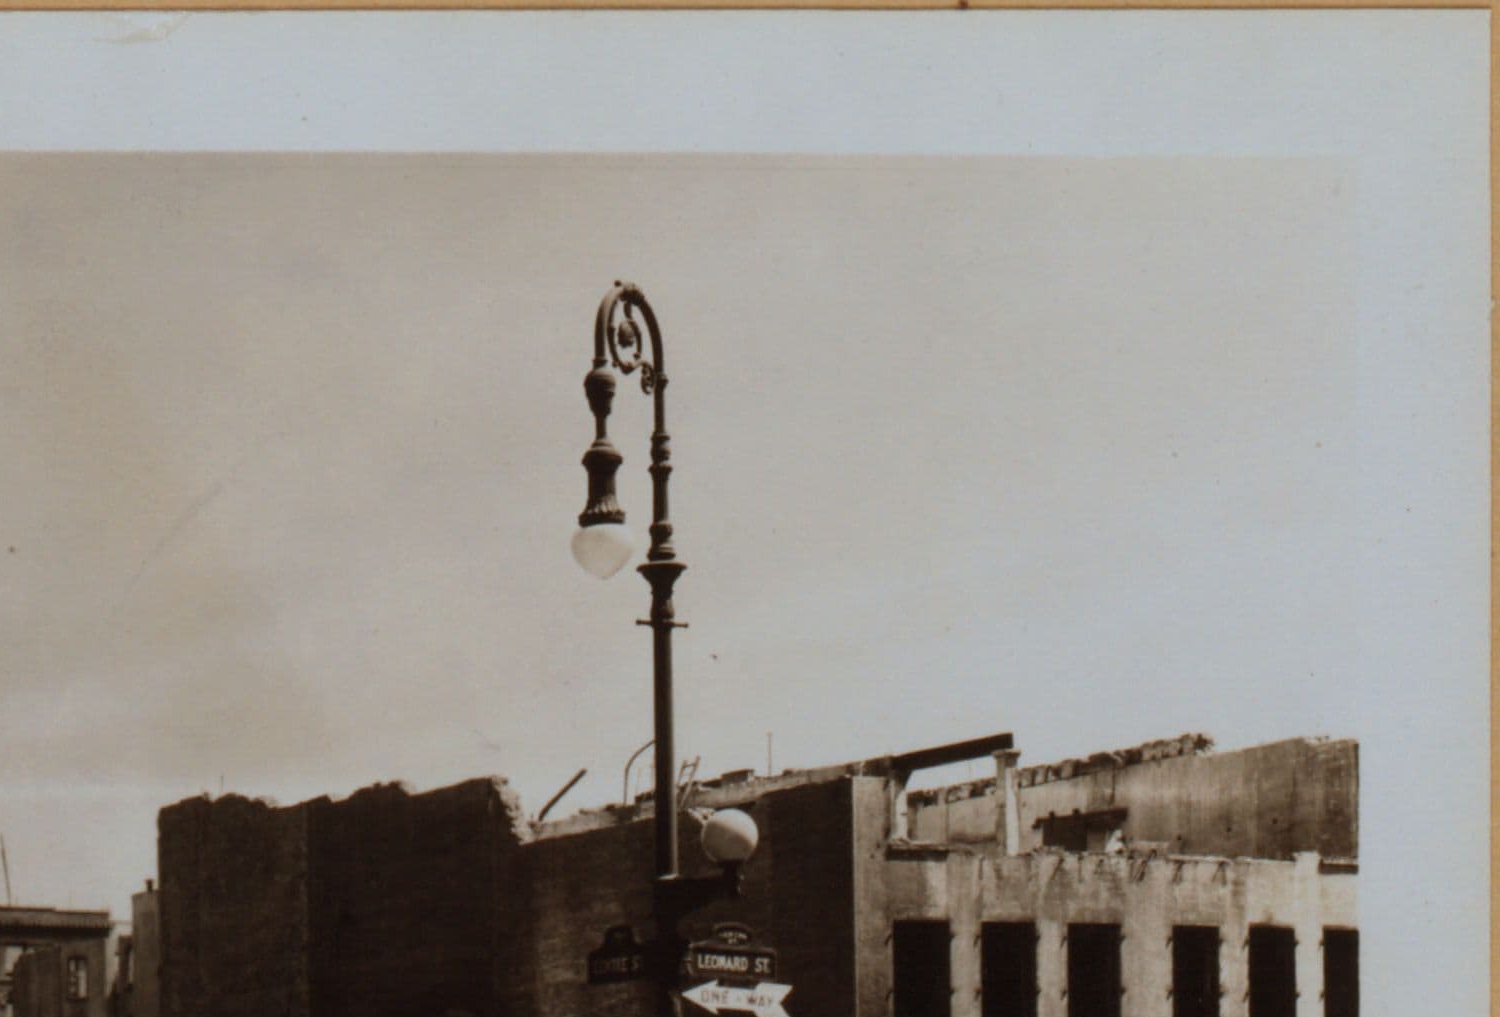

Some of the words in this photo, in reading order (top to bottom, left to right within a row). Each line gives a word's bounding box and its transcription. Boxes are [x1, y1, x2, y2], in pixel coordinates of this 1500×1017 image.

[697, 953, 749, 971] LEONARD
[700, 990, 729, 1004] ONE
[747, 995, 773, 1007] WAY
